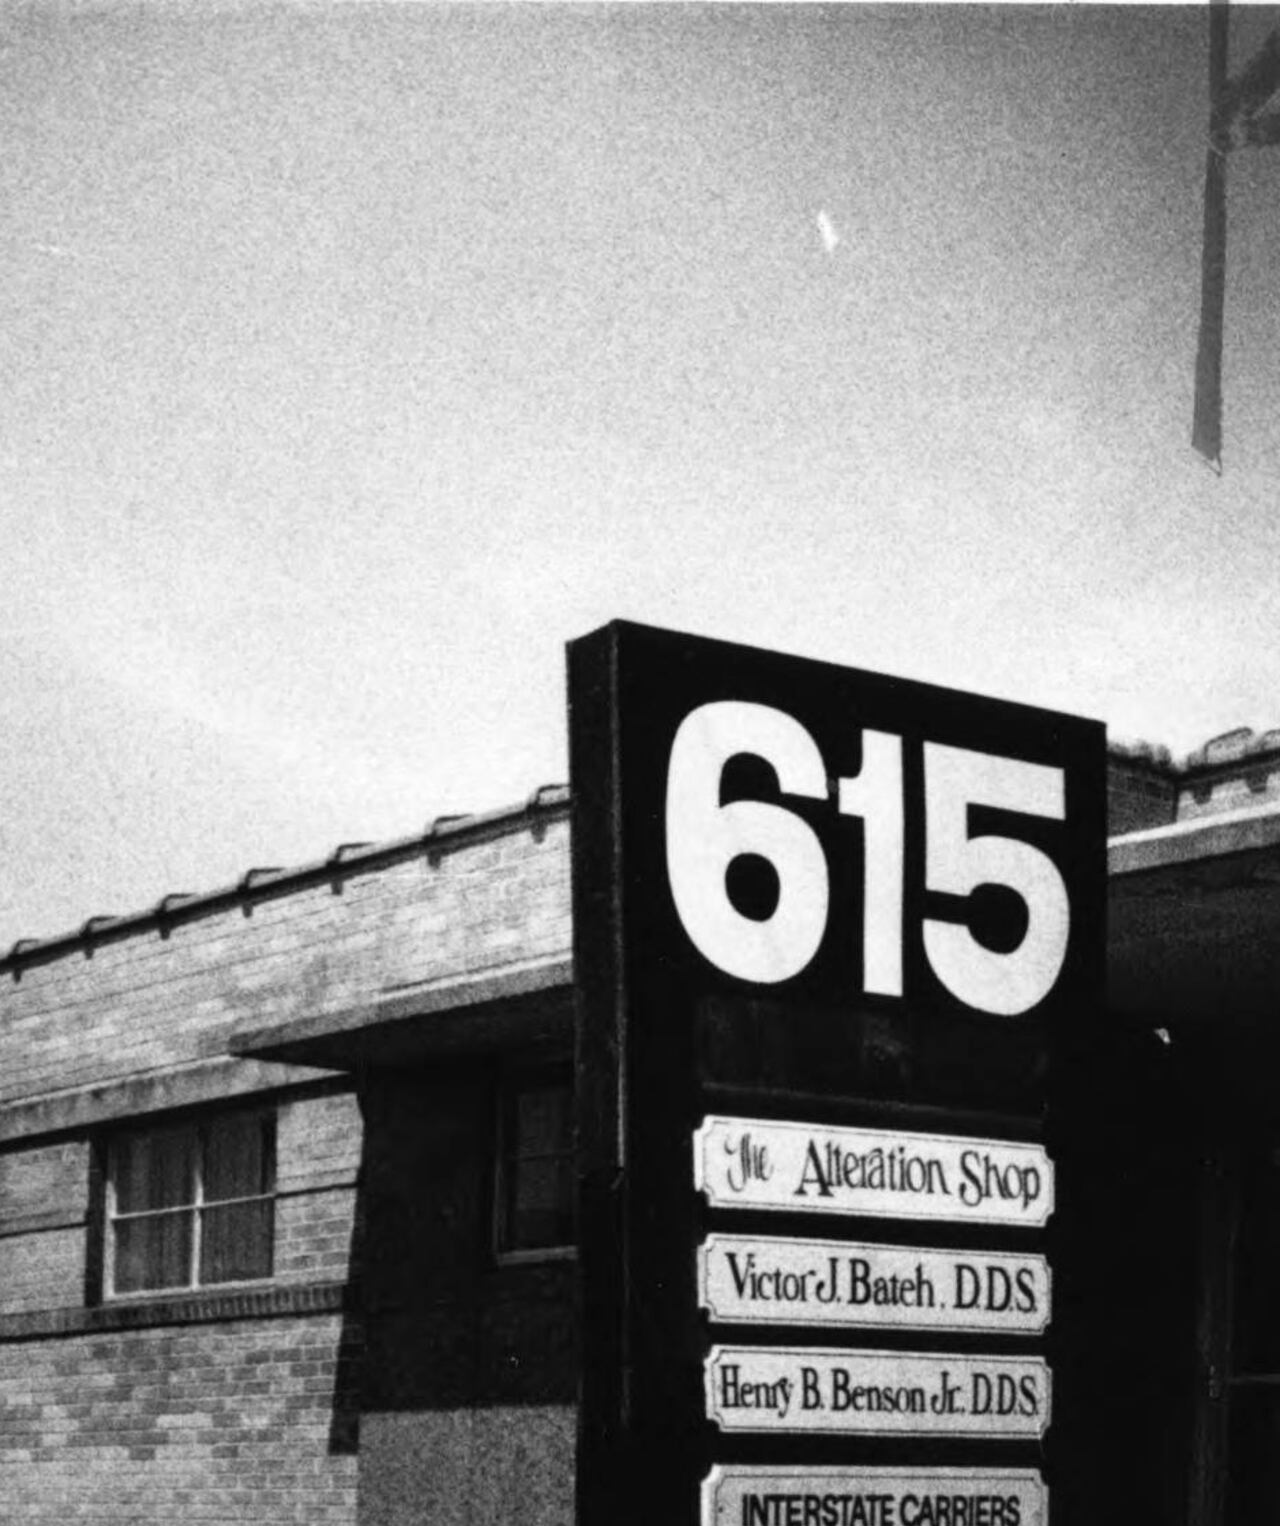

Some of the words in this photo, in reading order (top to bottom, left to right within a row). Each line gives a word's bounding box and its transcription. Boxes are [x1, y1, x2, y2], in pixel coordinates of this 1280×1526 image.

[666, 700, 1070, 1016] 615
[724, 1132, 774, 1192] The
[794, 1138, 951, 1197] Alteration
[959, 1150, 1040, 1211] Shop
[725, 1252, 816, 1302] Victor
[720, 1364, 791, 1418] Henry
[801, 1367, 825, 1410] B.
[831, 1367, 926, 1413] Benson
